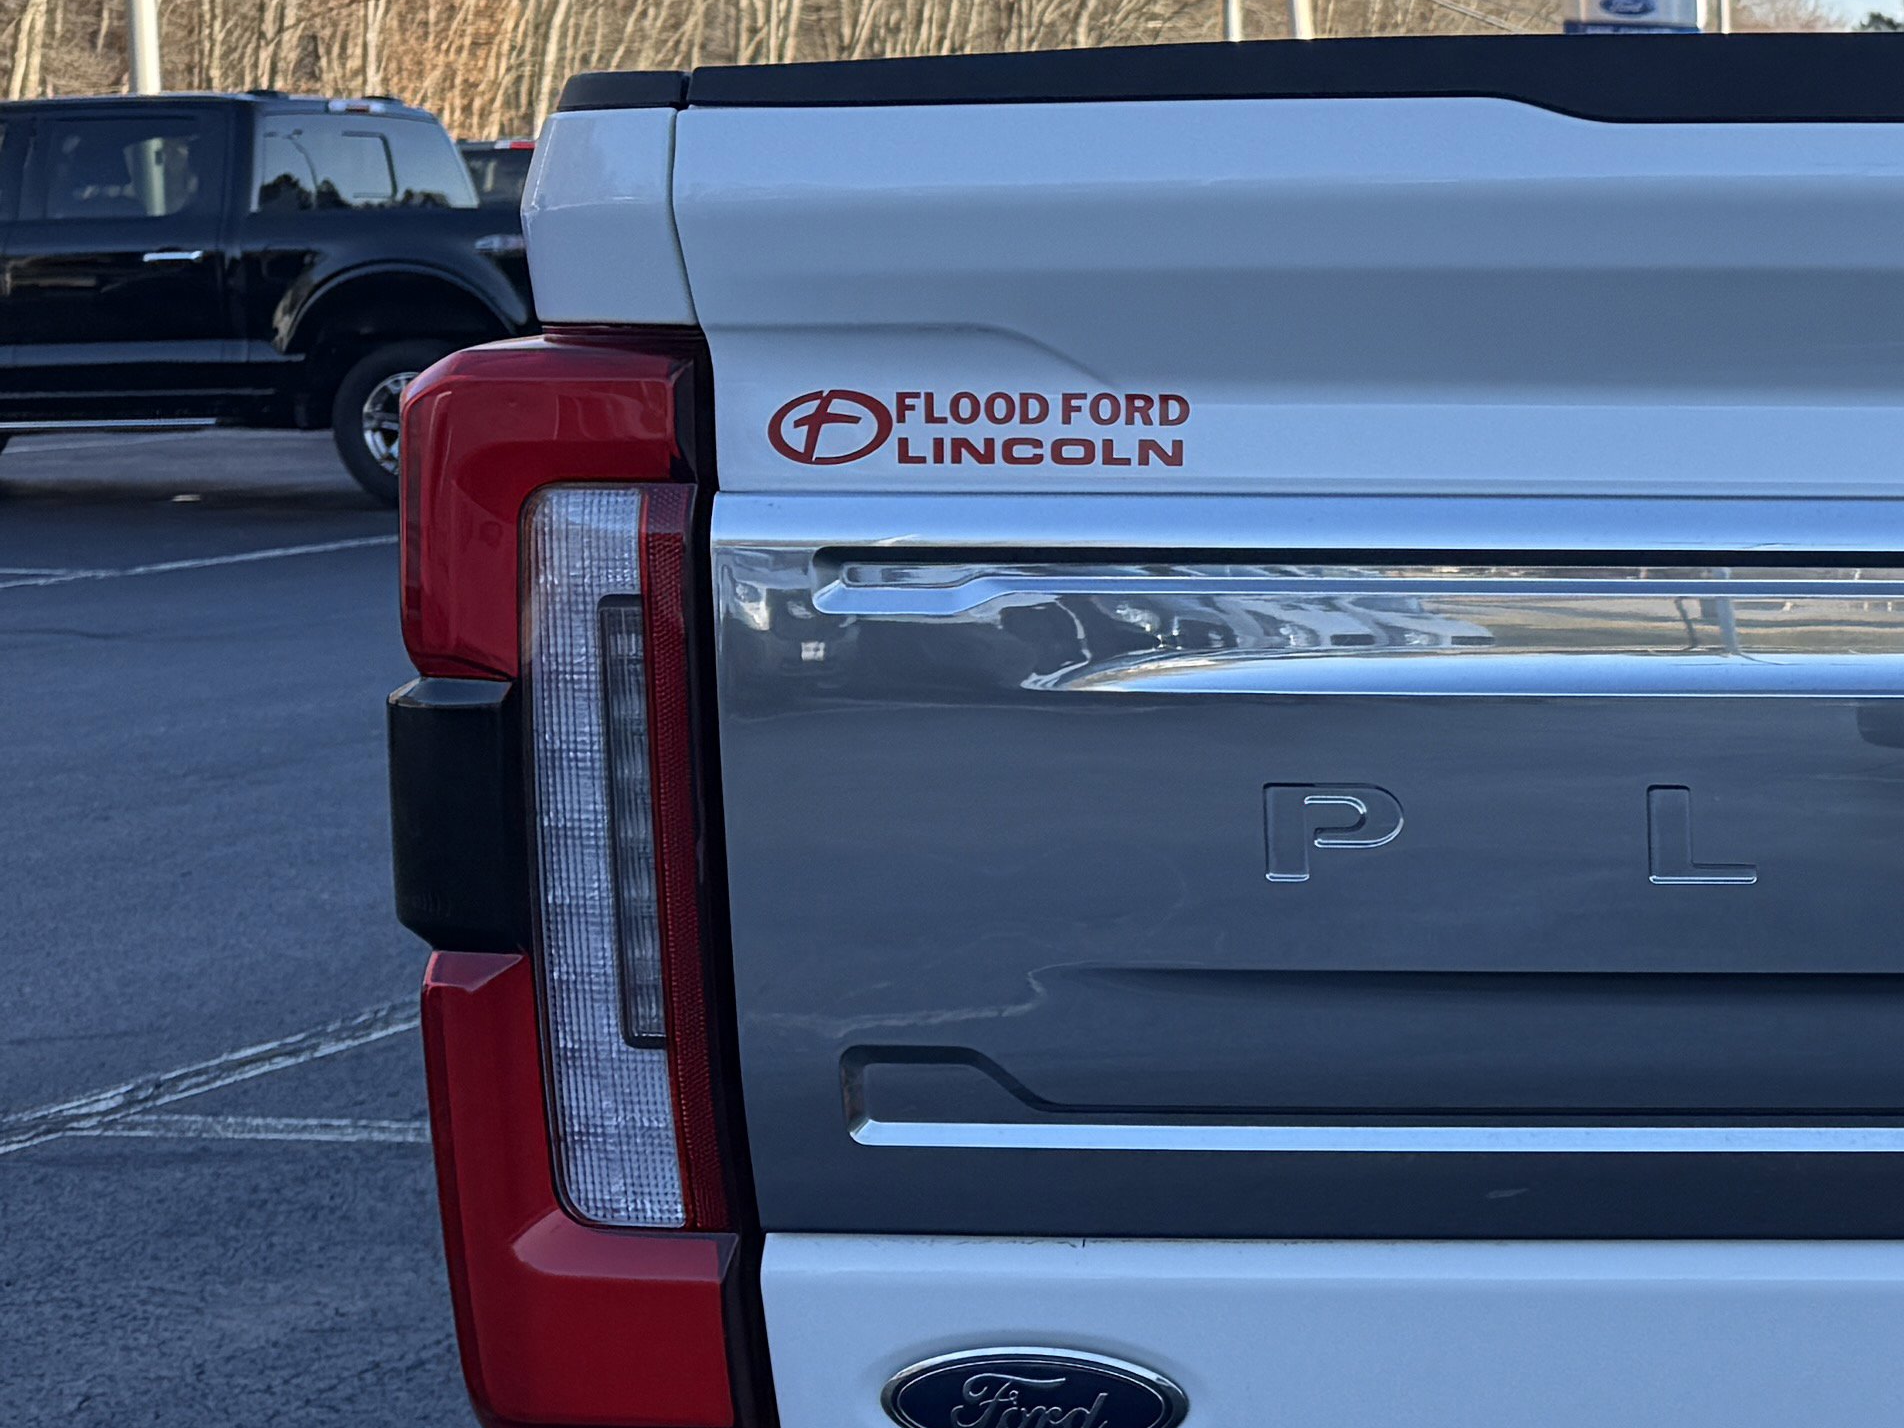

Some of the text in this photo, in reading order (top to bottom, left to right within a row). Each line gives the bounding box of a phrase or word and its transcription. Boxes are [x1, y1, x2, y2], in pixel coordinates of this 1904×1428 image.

[895, 391, 1191, 427] FLOOD FORD
[897, 436, 1184, 467] LINCOLN
